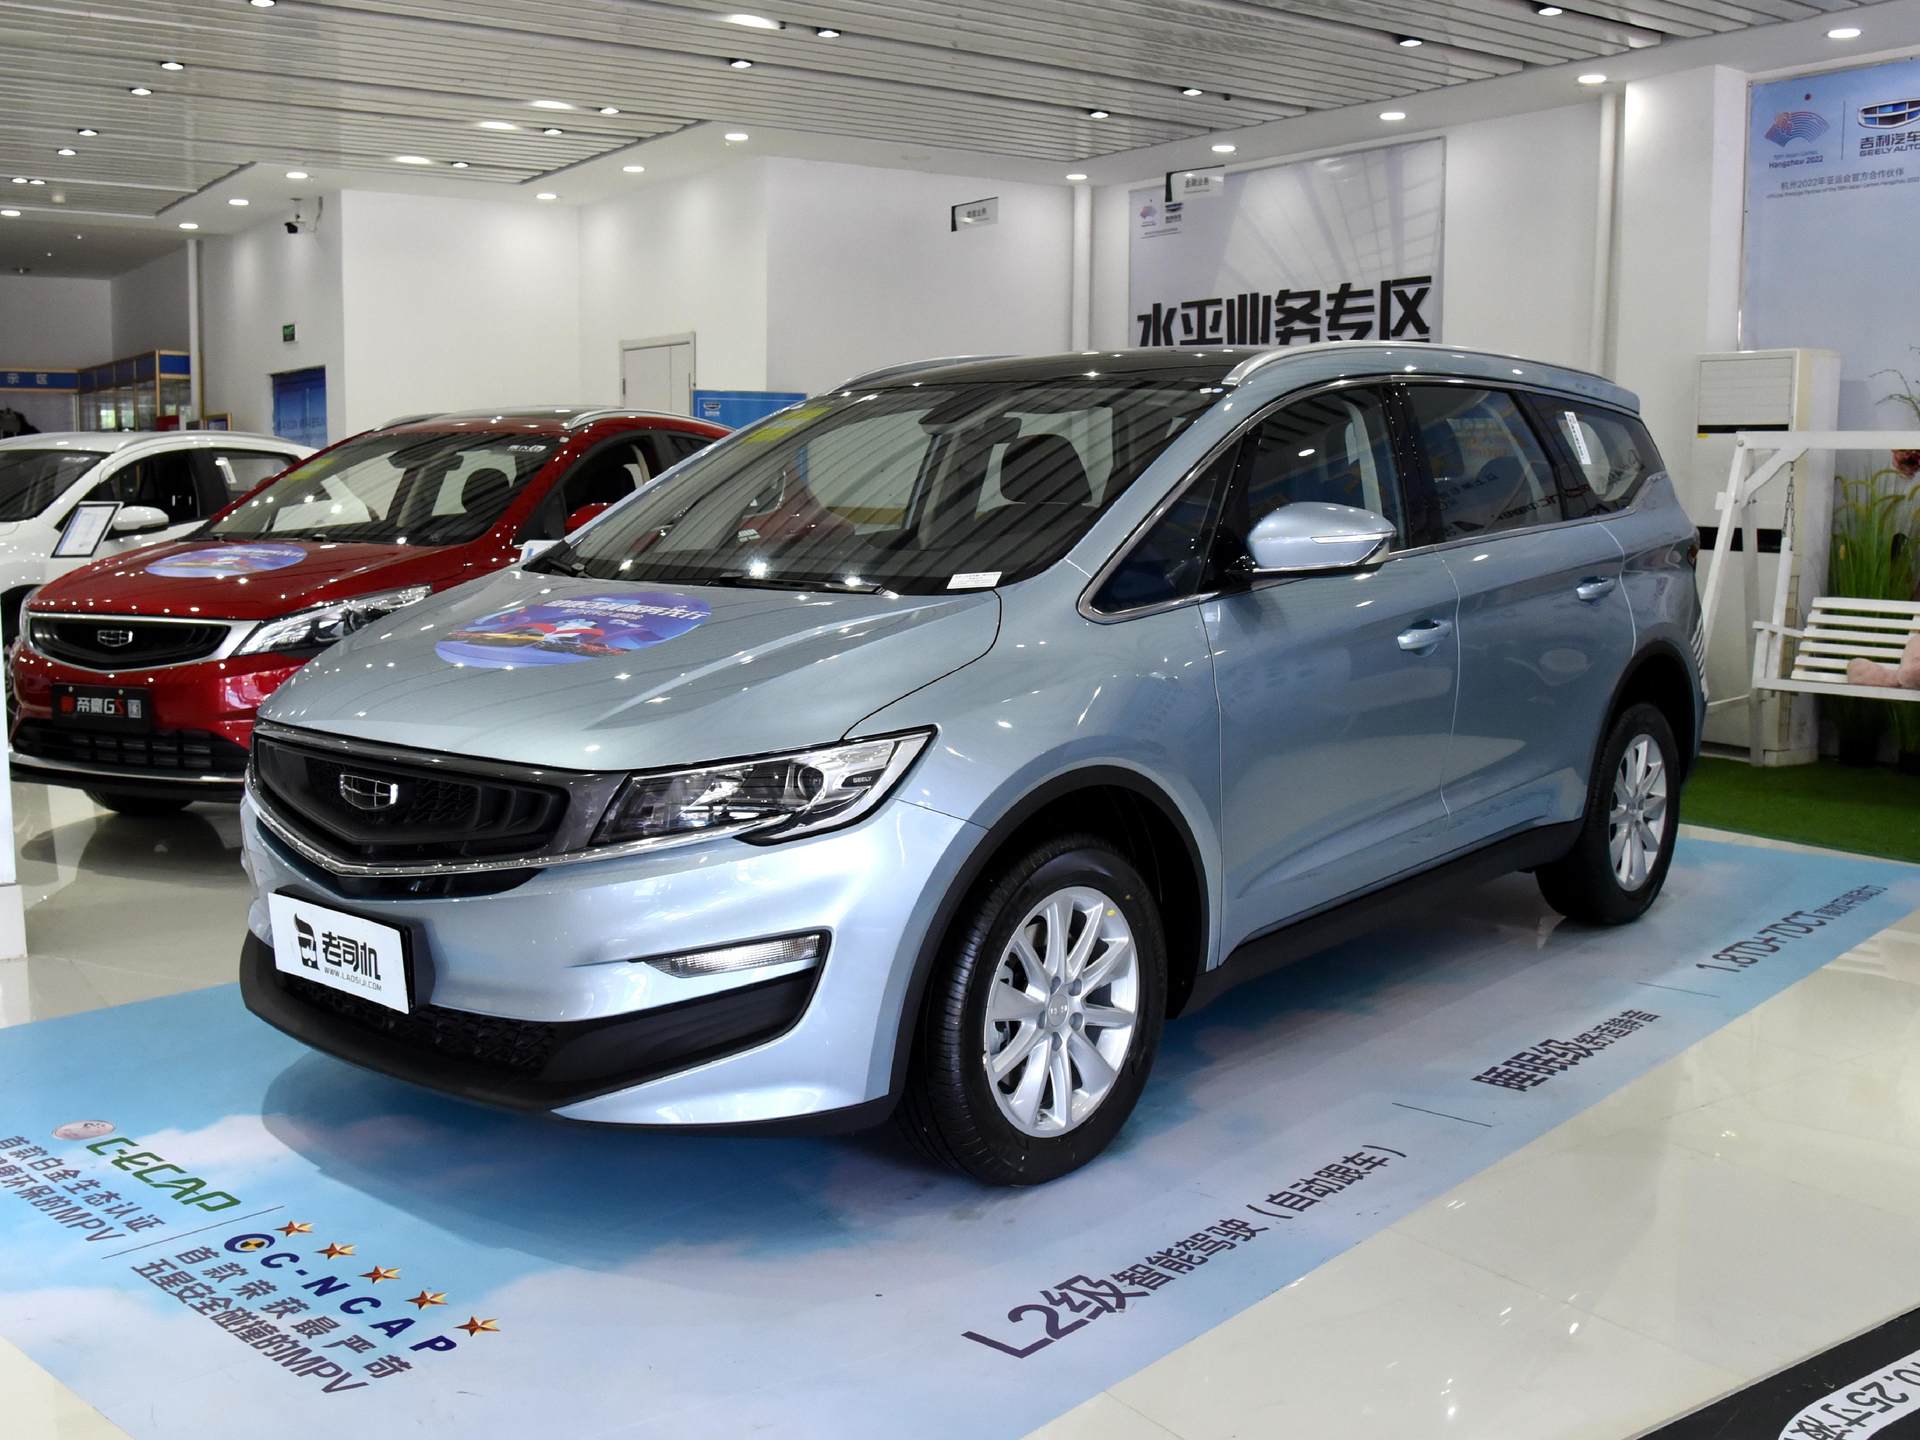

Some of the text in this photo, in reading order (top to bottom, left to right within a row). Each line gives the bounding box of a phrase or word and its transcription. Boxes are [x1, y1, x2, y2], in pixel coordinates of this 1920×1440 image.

[1768, 155, 1824, 169] Hangzhou 2022
[1859, 147, 1893, 157] GEELY
[1860, 130, 1920, 150] 吉利汽车
[321, 931, 381, 981] 老司机
[324, 967, 382, 991] WWW.LAOSIJI.COM
[1471, 1009, 1661, 1092] 睡眠级舒适静音
[0, 1135, 166, 1232] 首款白金生态认证
[0, 1156, 125, 1242] 康环保的MPV
[131, 1258, 369, 1394] 五星安全碰撞的MPV
[175, 1246, 414, 1380] 首款荣获最严苛
